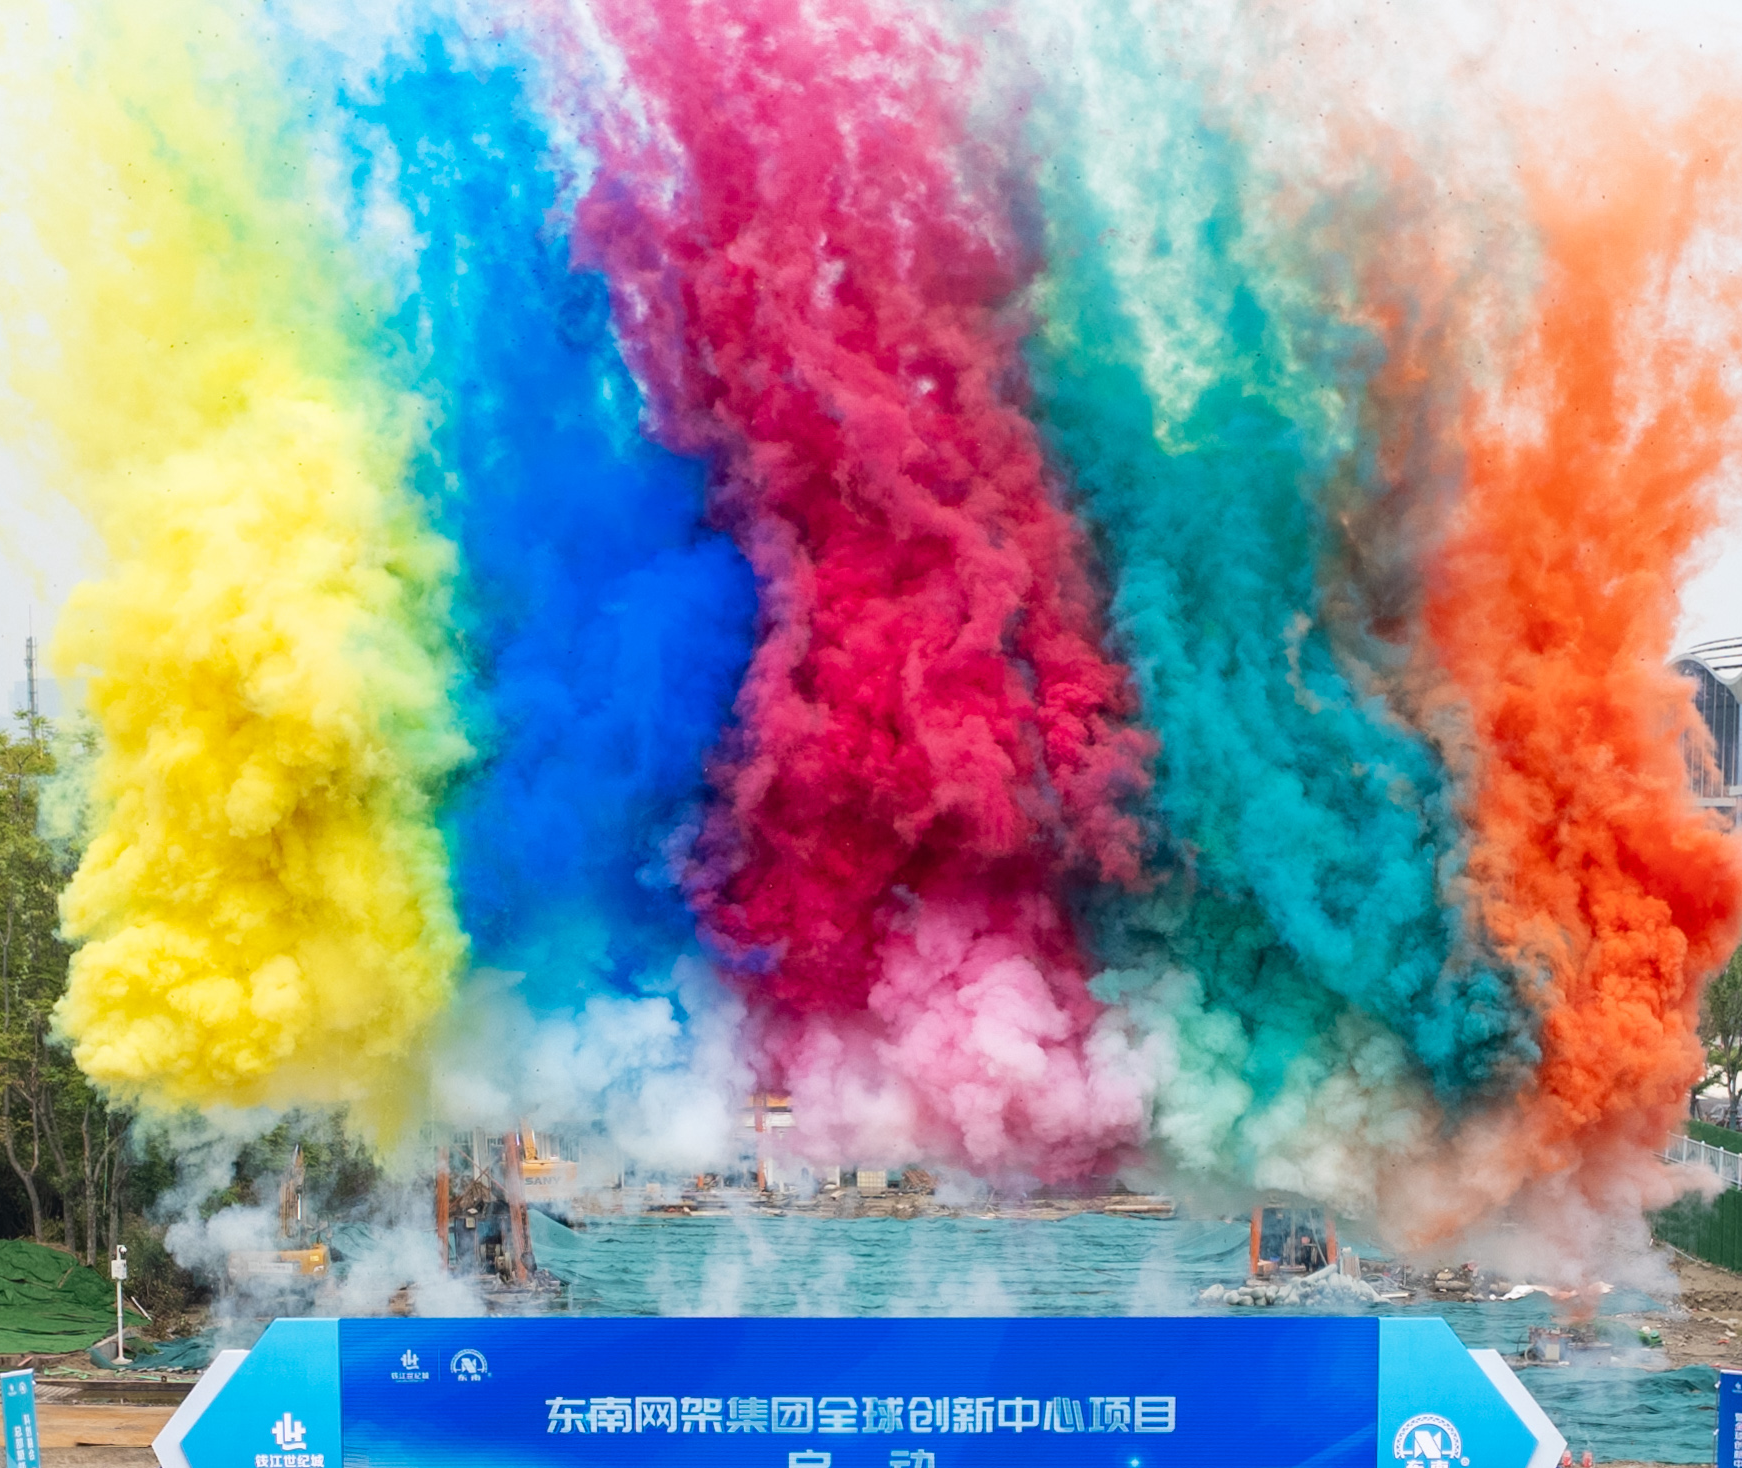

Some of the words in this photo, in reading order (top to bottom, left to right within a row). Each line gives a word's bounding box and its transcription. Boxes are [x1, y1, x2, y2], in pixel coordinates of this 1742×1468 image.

[524, 1176, 561, 1186] SANY
[545, 1396, 1177, 1434] 东南网架集团全球创新中心项目
[255, 1454, 325, 1468] 钱江世纪城
